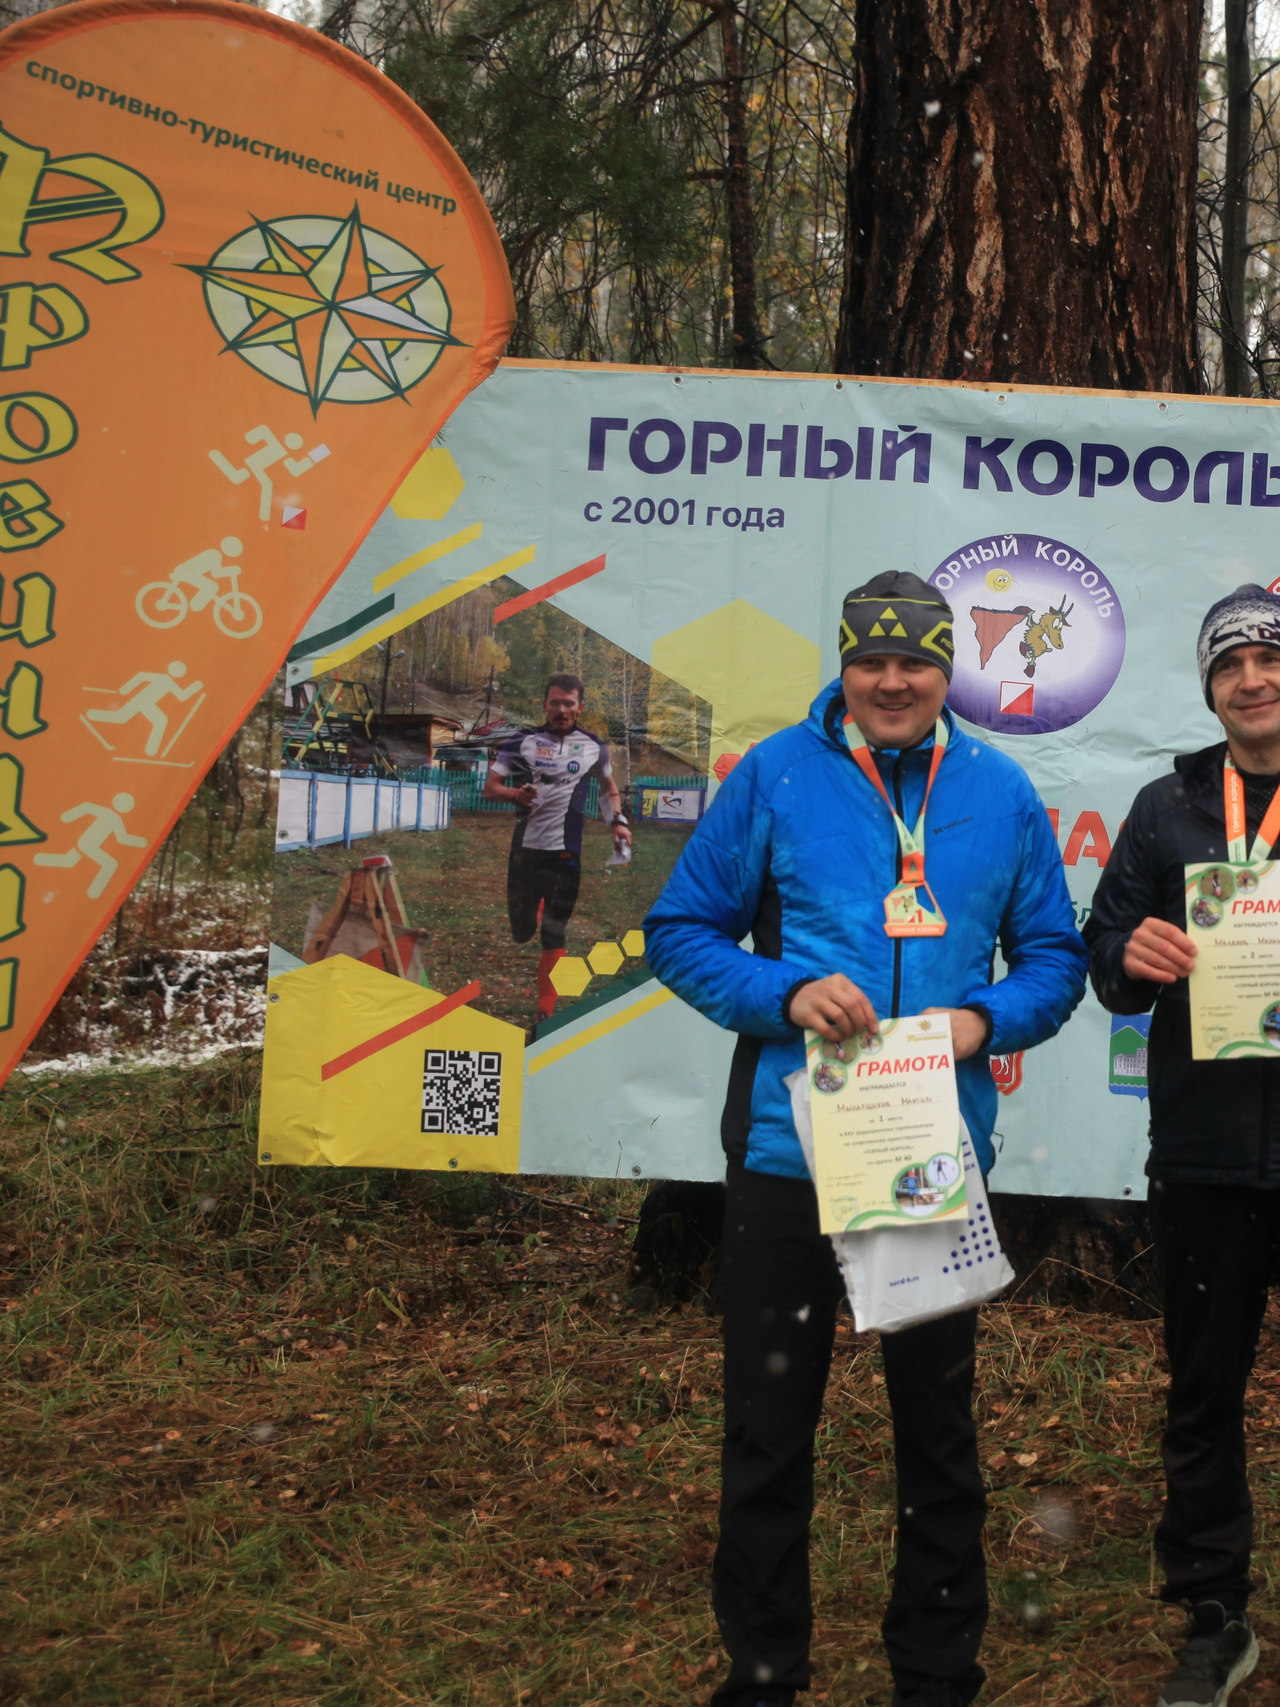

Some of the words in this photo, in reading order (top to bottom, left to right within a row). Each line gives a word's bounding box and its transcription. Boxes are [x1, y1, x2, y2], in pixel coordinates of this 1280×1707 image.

[26, 59, 379, 191] спортивно-туристический
[385, 179, 457, 216] центр
[587, 416, 932, 484] ГОРНЫЙ
[583, 501, 603, 523] с
[611, 496, 696, 526] 2001
[706, 506, 785, 532] года
[934, 534, 1020, 591] ОРНЫЙ
[1035, 541, 1115, 618] КОРОЛЬ
[856, 1053, 951, 1078] ГРАМОТА
